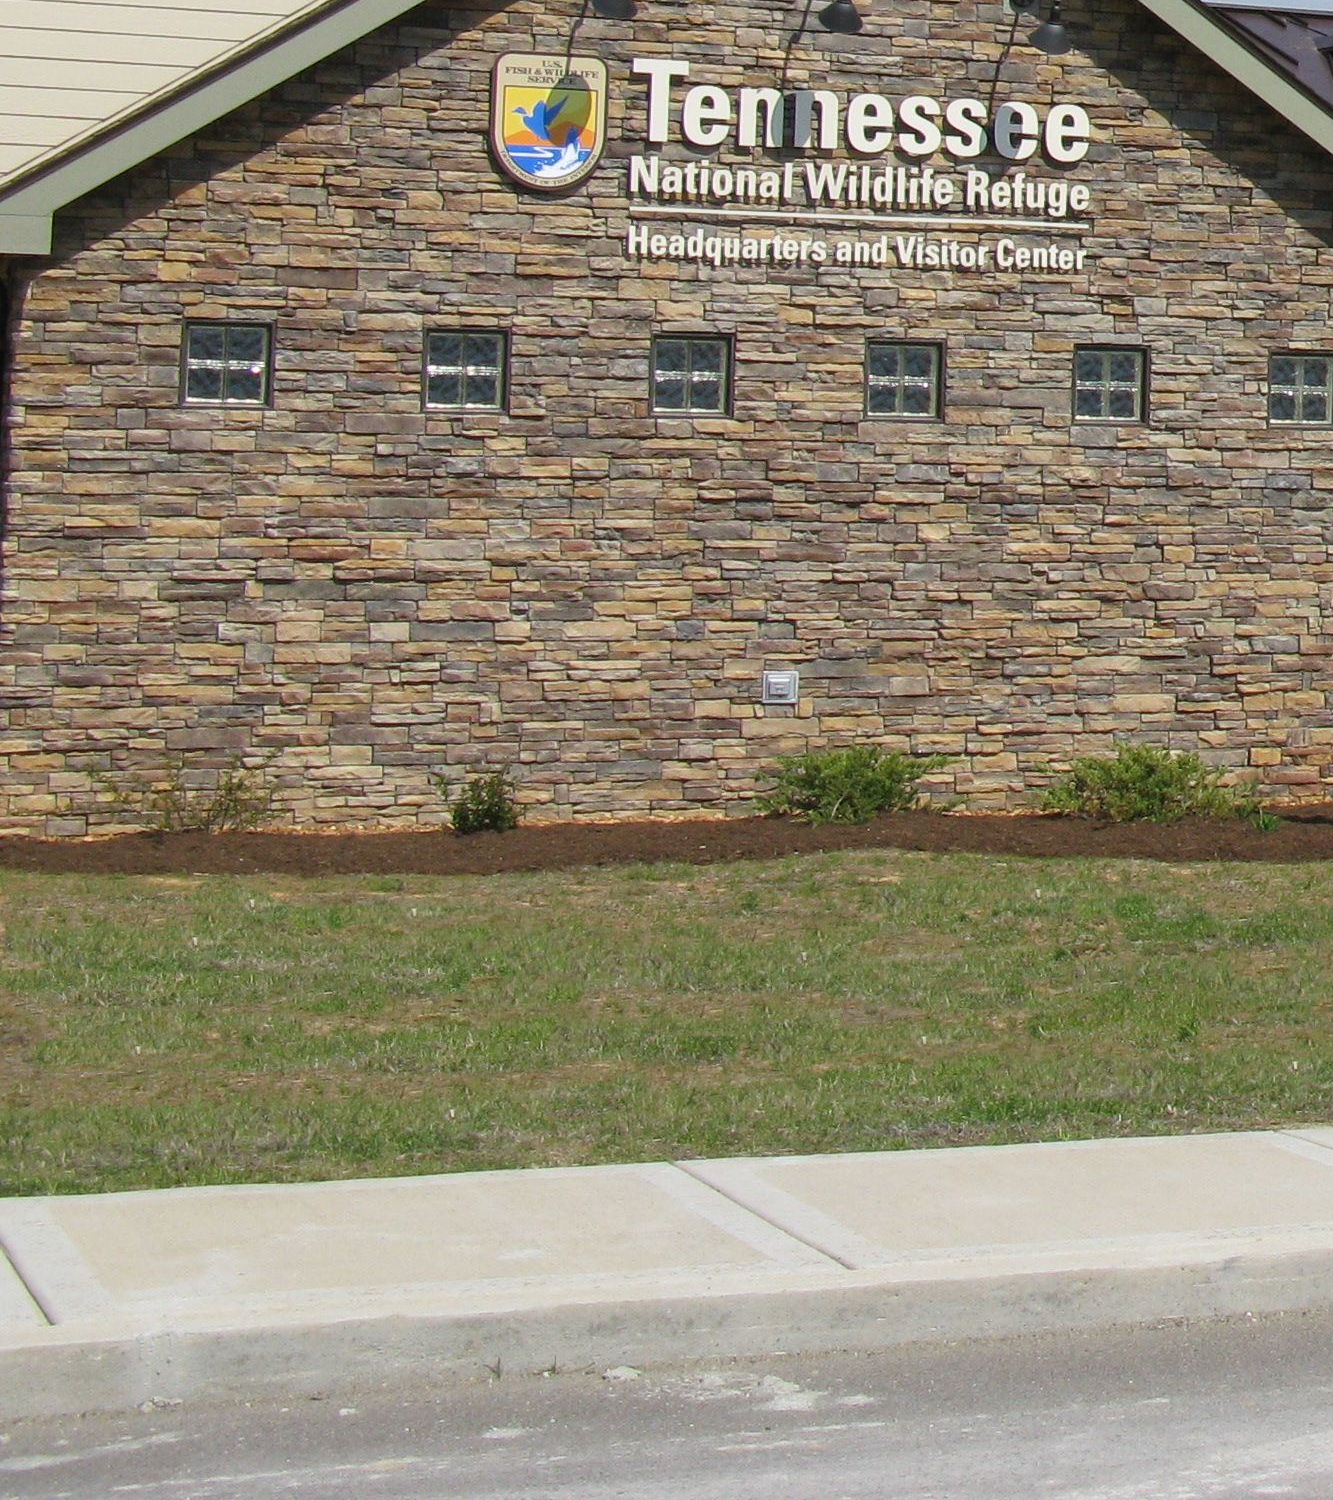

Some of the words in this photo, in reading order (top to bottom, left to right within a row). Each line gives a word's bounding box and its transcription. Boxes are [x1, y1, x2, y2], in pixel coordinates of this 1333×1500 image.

[505, 66, 532, 75] FISH
[544, 68, 600, 79] WILDLIFE
[542, 59, 563, 69] U.S.
[527, 75, 576, 85] SERVICE
[633, 58, 1090, 162] Tennessee
[630, 155, 793, 199] National
[805, 162, 954, 206] Wildlife
[966, 170, 1090, 217] Refuge
[628, 225, 827, 266] Headquarters
[836, 236, 888, 263] and
[896, 235, 989, 266] Visitor
[996, 238, 1088, 270] Center
